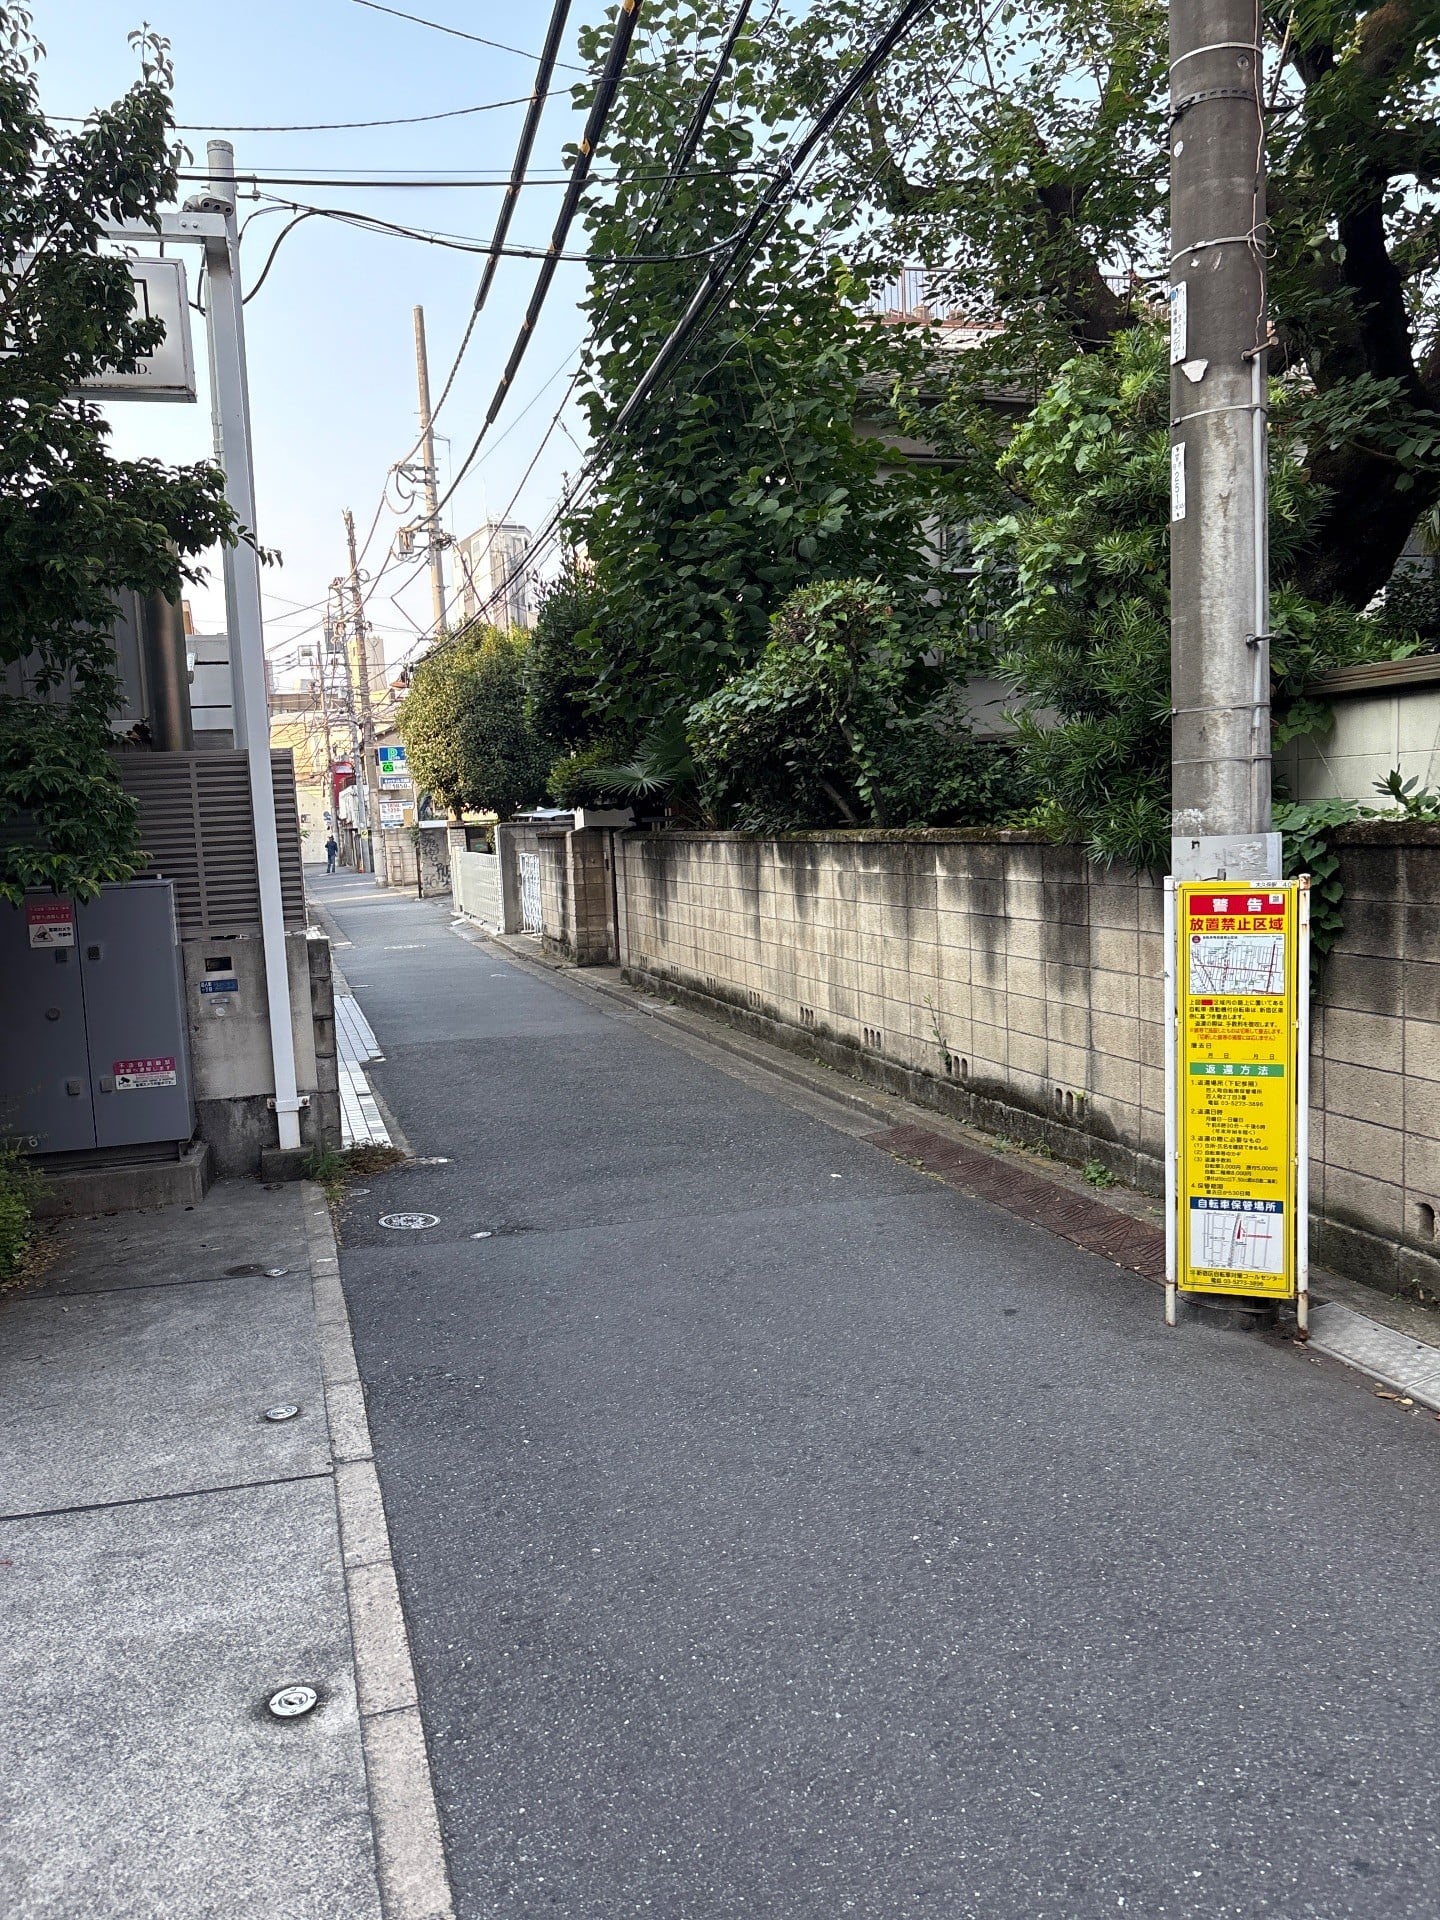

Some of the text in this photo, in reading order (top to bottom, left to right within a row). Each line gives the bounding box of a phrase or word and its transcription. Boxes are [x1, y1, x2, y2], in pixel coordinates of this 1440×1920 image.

[1212, 898, 1262, 912] 警告
[1190, 918, 1283, 930] 放置禁止区域
[1205, 1064, 1268, 1075] 返還方法
[1198, 1199, 1276, 1212] 自転車保管場所
